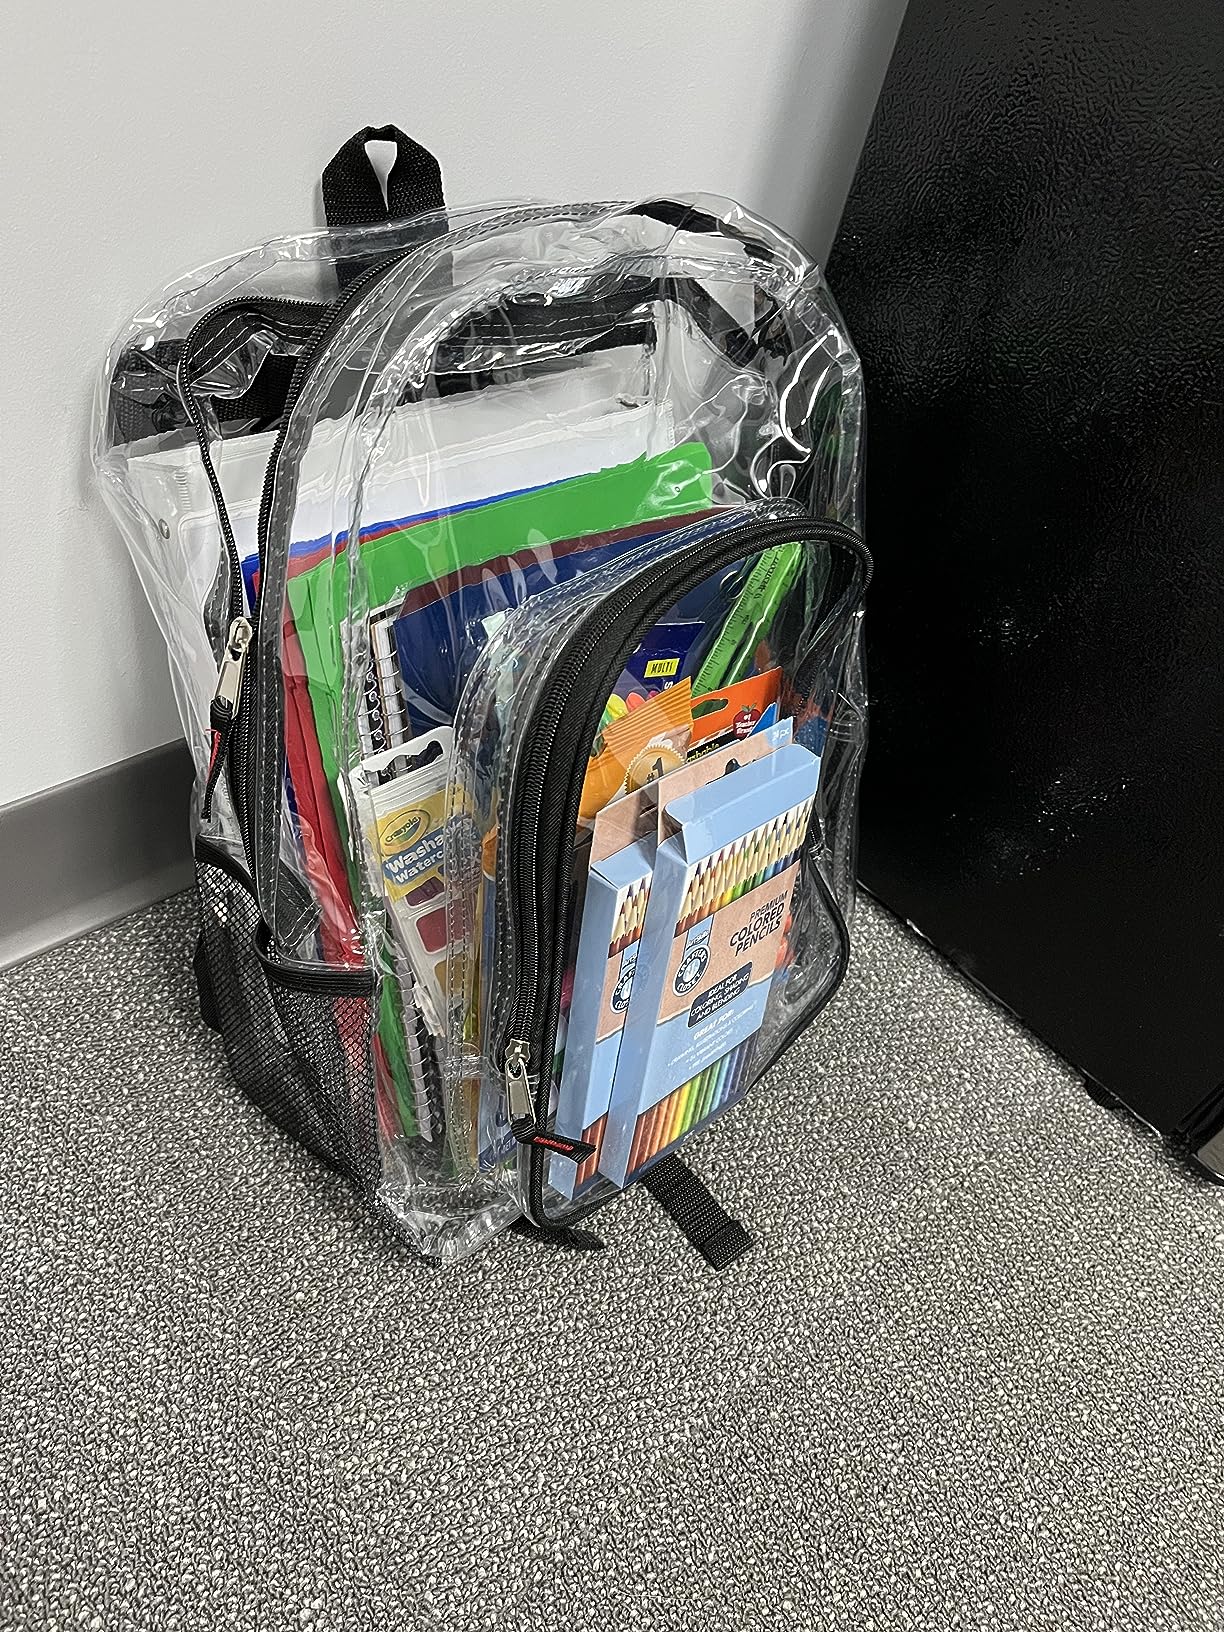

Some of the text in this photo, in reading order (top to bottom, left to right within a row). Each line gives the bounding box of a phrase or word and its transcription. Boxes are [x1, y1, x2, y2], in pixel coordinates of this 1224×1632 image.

[651, 662, 673, 674] MULTI
[385, 816, 421, 843] Crayola
[386, 834, 444, 873] Washa
[396, 850, 444, 883] Waterc
[749, 890, 788, 922] PREMIUM
[730, 903, 785, 946] COLORED
[735, 916, 782, 957] PENCILS
[708, 974, 738, 998] IDEAL FOR
[724, 972, 750, 995] SHADING
[696, 987, 740, 1021] AND BLENDING
